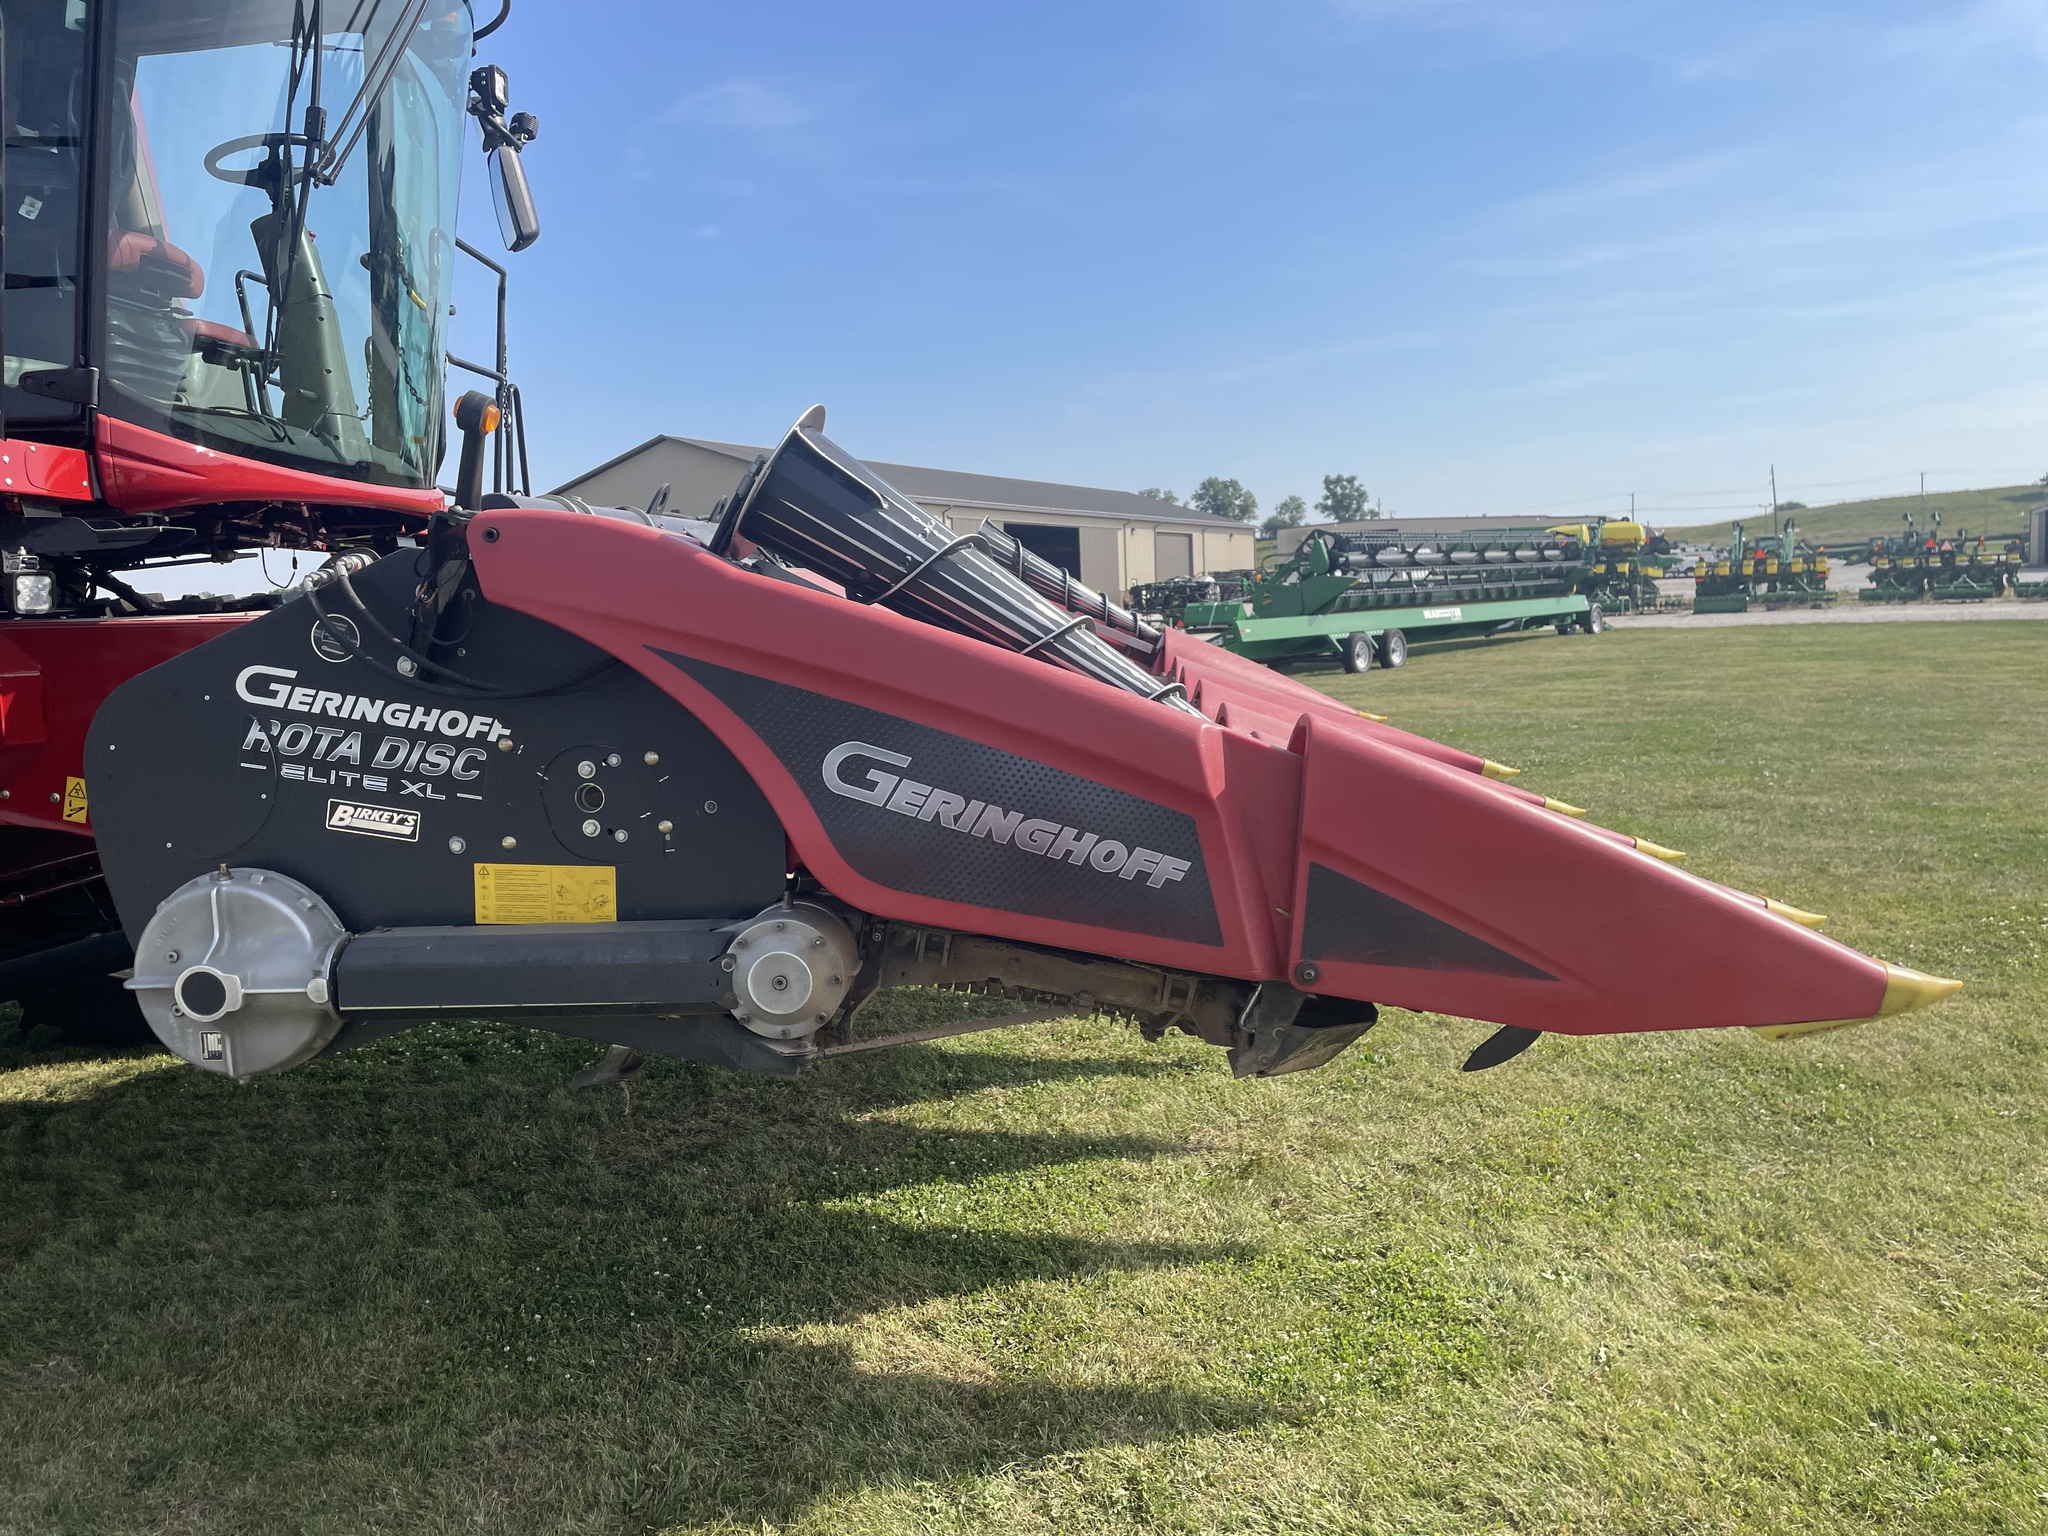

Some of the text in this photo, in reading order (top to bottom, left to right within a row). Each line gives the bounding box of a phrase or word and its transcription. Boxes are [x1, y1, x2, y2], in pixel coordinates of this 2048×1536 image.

[235, 664, 511, 742] GERINGHOFF
[242, 719, 487, 780] ROTA DISC
[280, 762, 446, 800] ELITE XL
[329, 804, 417, 827] BIRKEY'S
[822, 741, 1192, 888] GERINGHOFF
